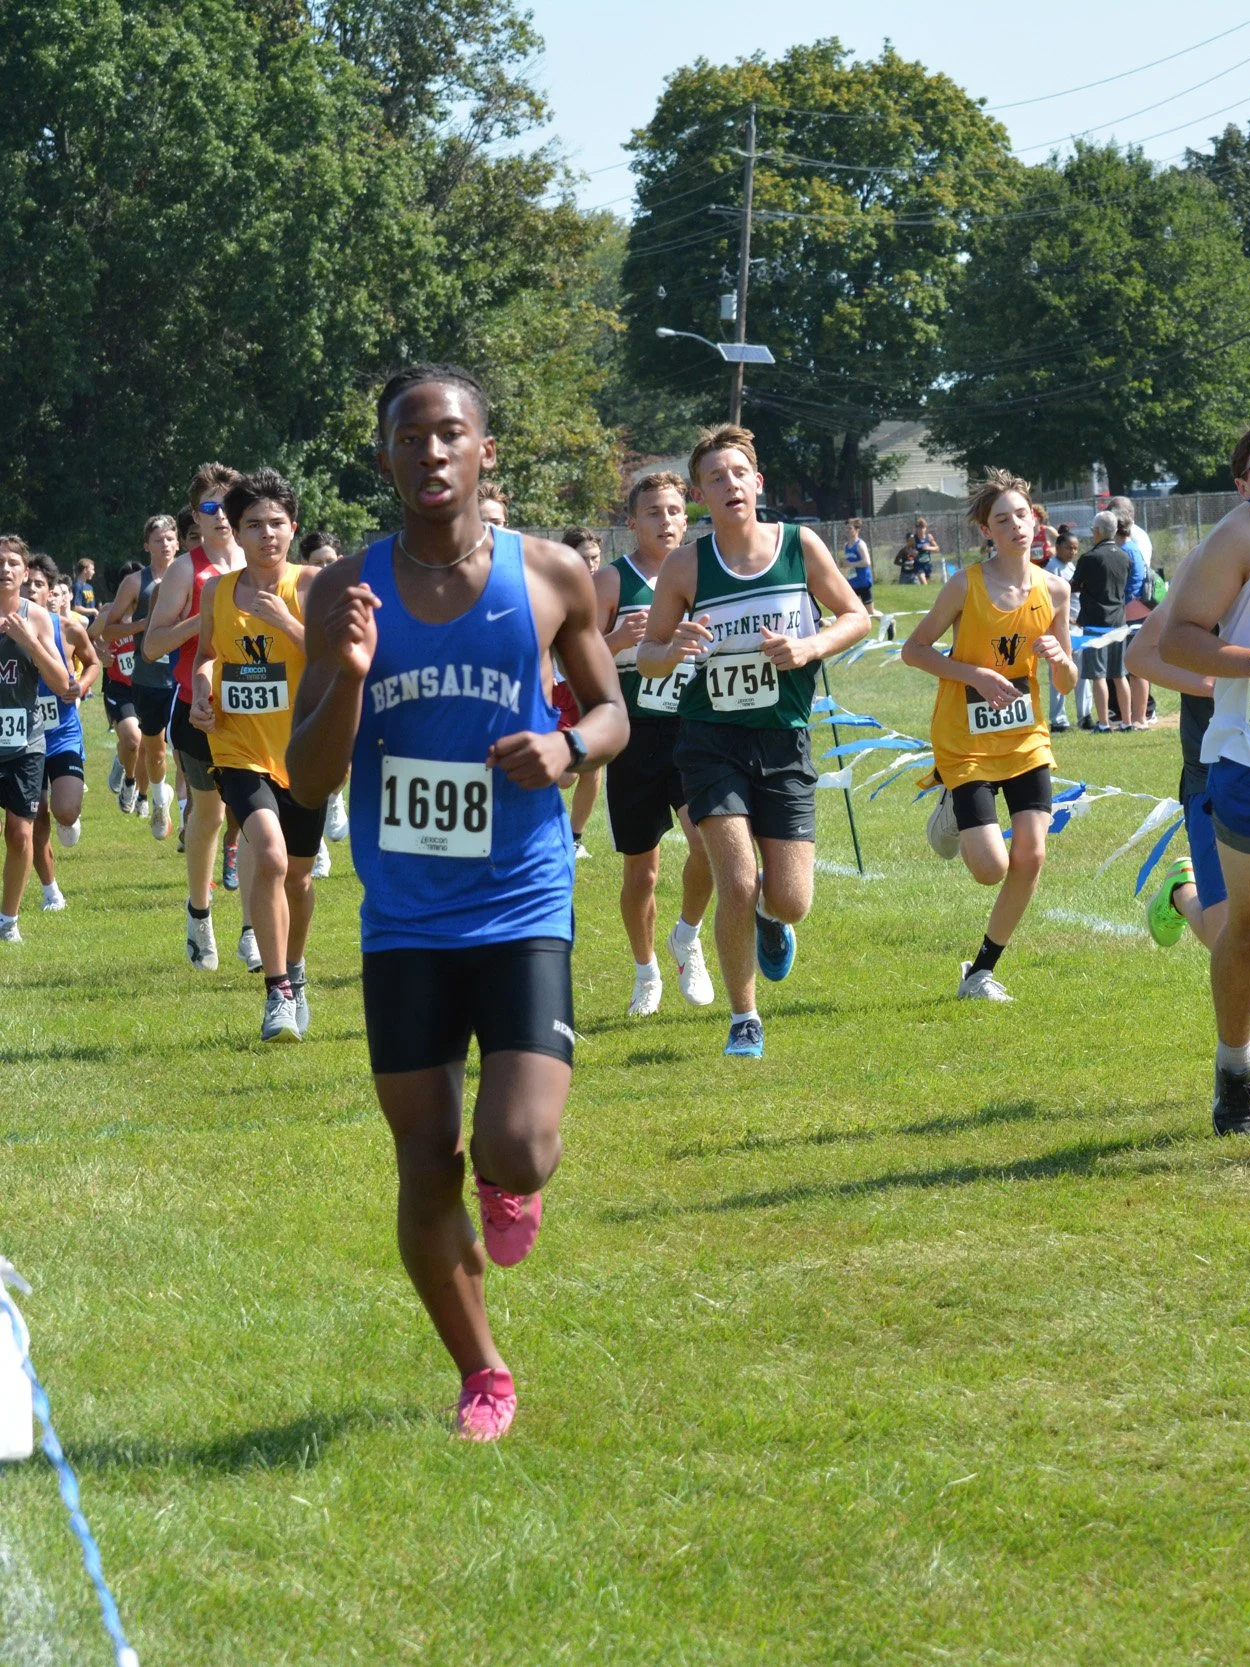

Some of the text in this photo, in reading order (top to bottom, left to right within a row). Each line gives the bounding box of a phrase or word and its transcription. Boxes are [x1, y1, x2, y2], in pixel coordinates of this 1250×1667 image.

[706, 610, 802, 643] STEINERT XC
[119, 657, 135, 671] 18
[709, 661, 776, 698] 1754
[227, 685, 279, 710] 6331
[370, 663, 521, 715] BENSALEM
[974, 699, 1028, 729] 6330
[384, 774, 488, 834] 1698
